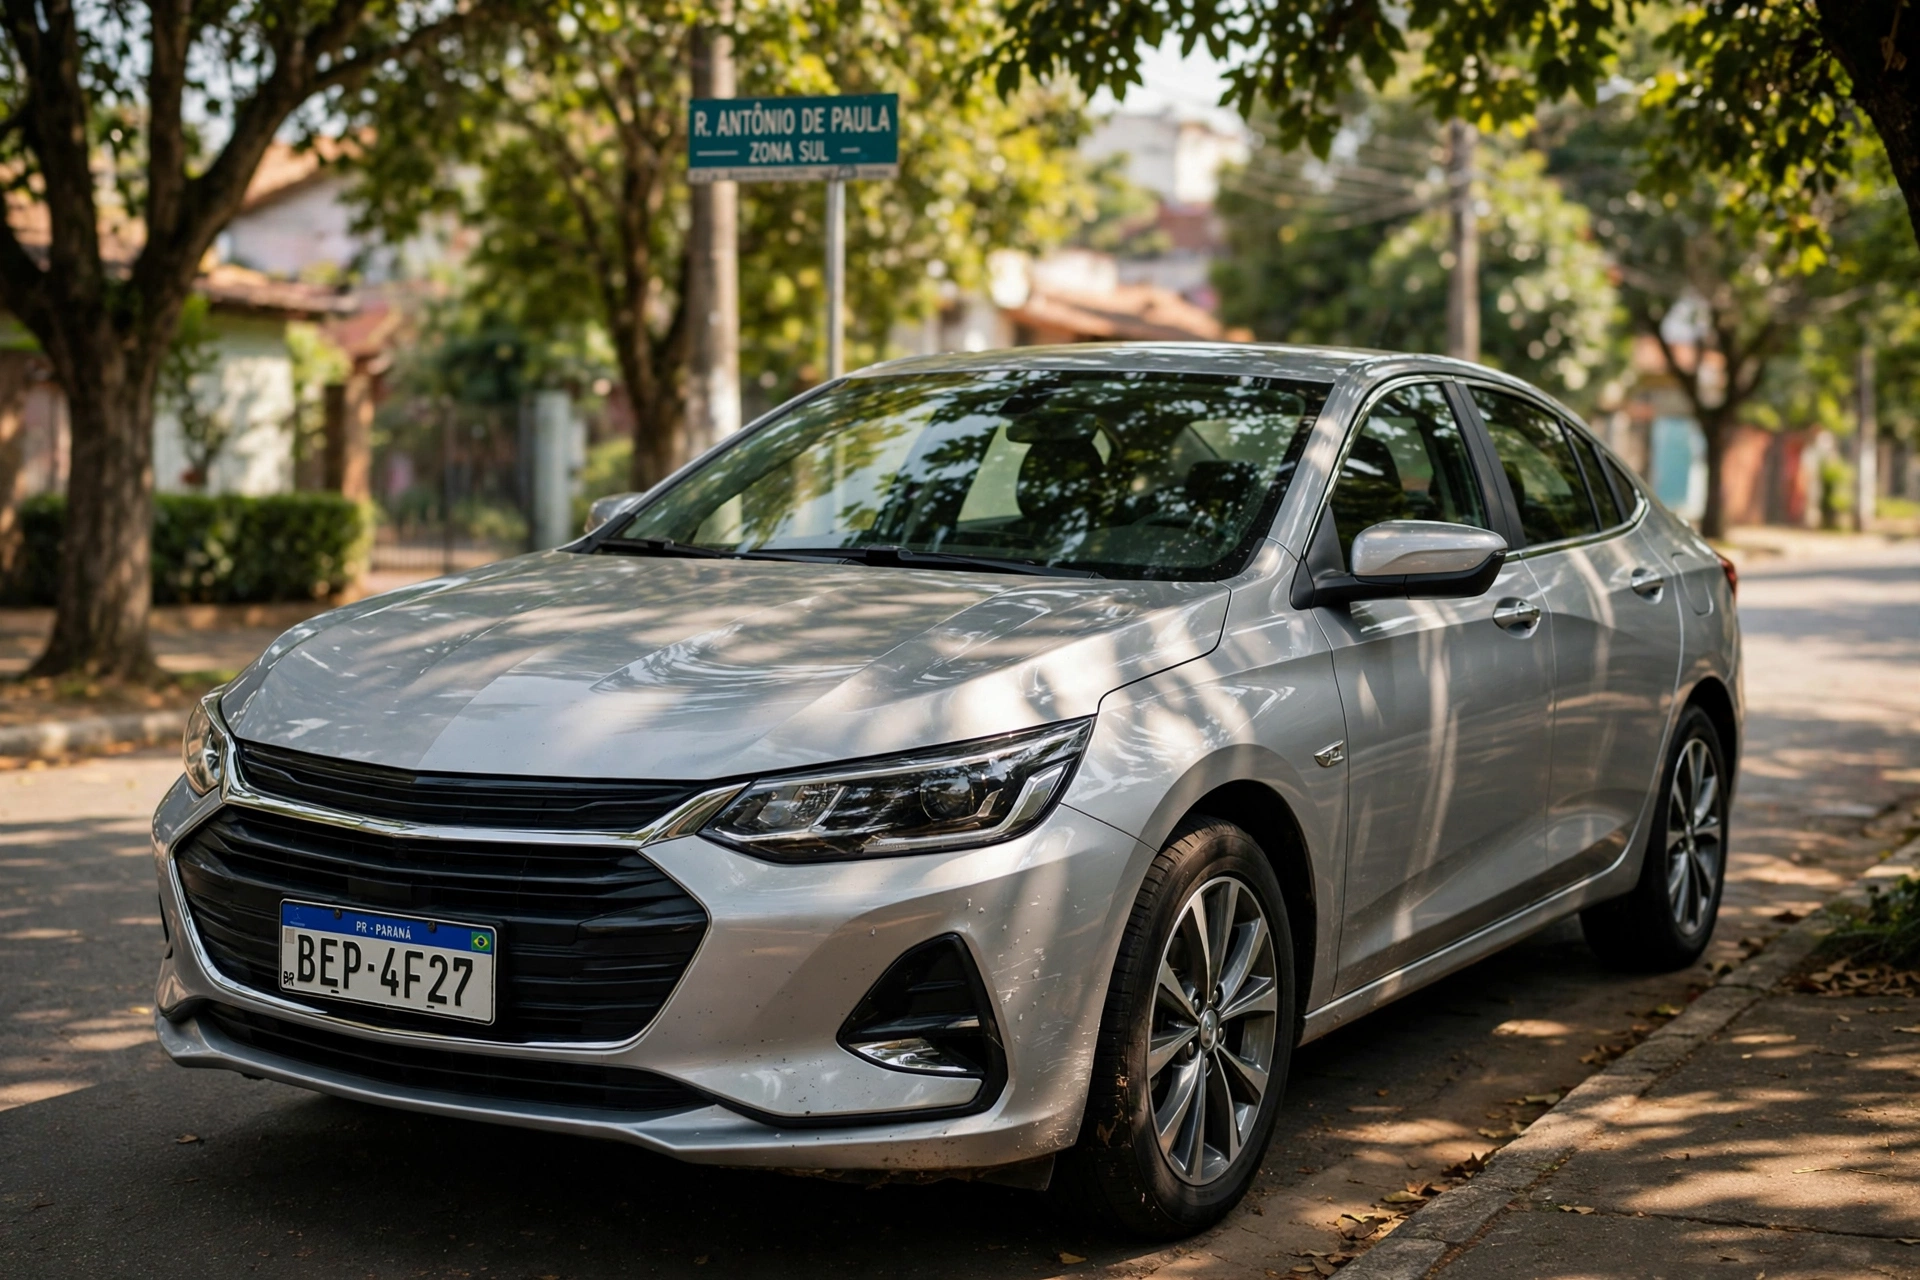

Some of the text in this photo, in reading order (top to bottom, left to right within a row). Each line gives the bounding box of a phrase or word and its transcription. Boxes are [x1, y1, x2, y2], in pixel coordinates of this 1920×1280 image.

[694, 101, 891, 137] R. ANTÔNIO DE PAULA
[749, 140, 829, 163] ZONA SUL
[356, 920, 367, 933] PR
[375, 924, 412, 940] PARANÁ
